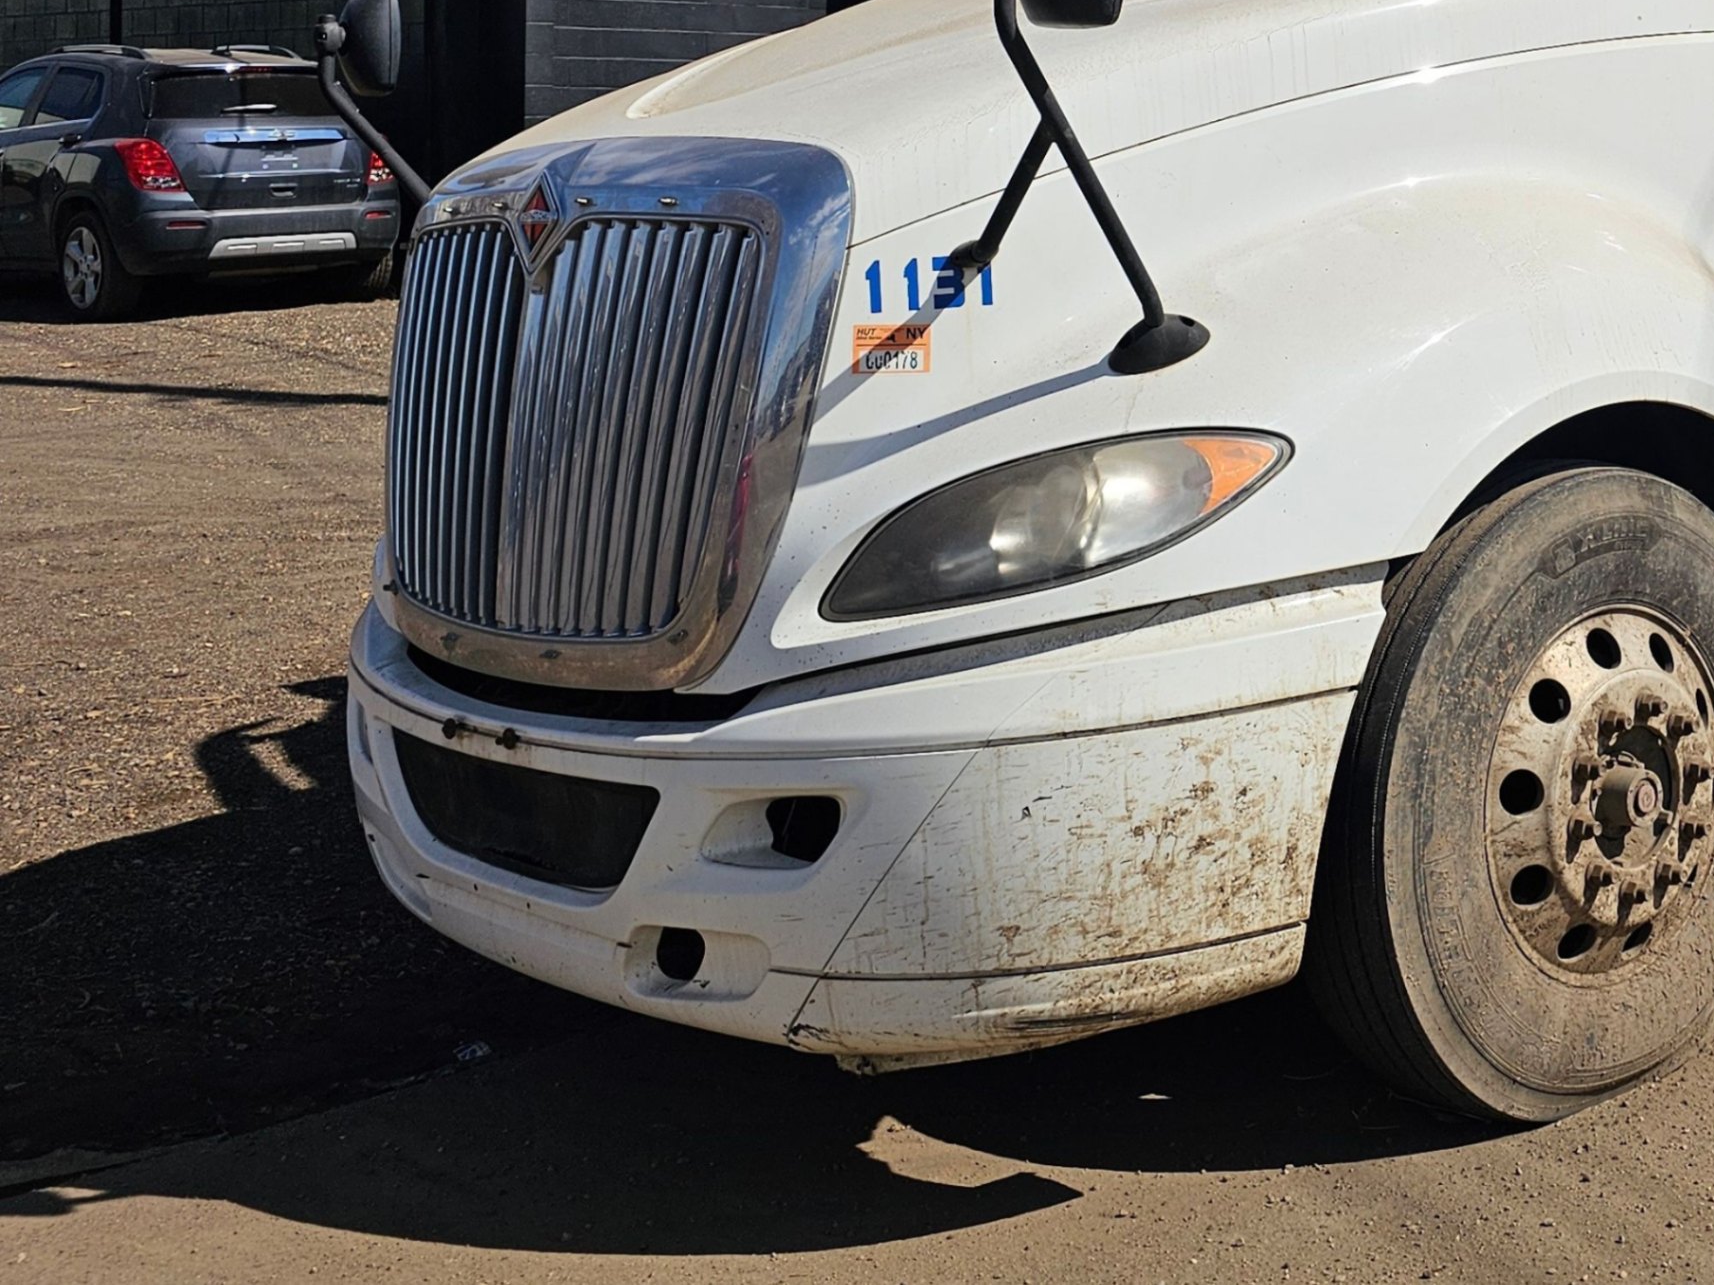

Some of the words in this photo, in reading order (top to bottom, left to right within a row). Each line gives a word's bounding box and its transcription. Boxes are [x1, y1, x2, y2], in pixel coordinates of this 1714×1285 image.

[865, 255, 993, 313] 1131
[857, 328, 877, 336] HUT
[906, 327, 927, 339] NY
